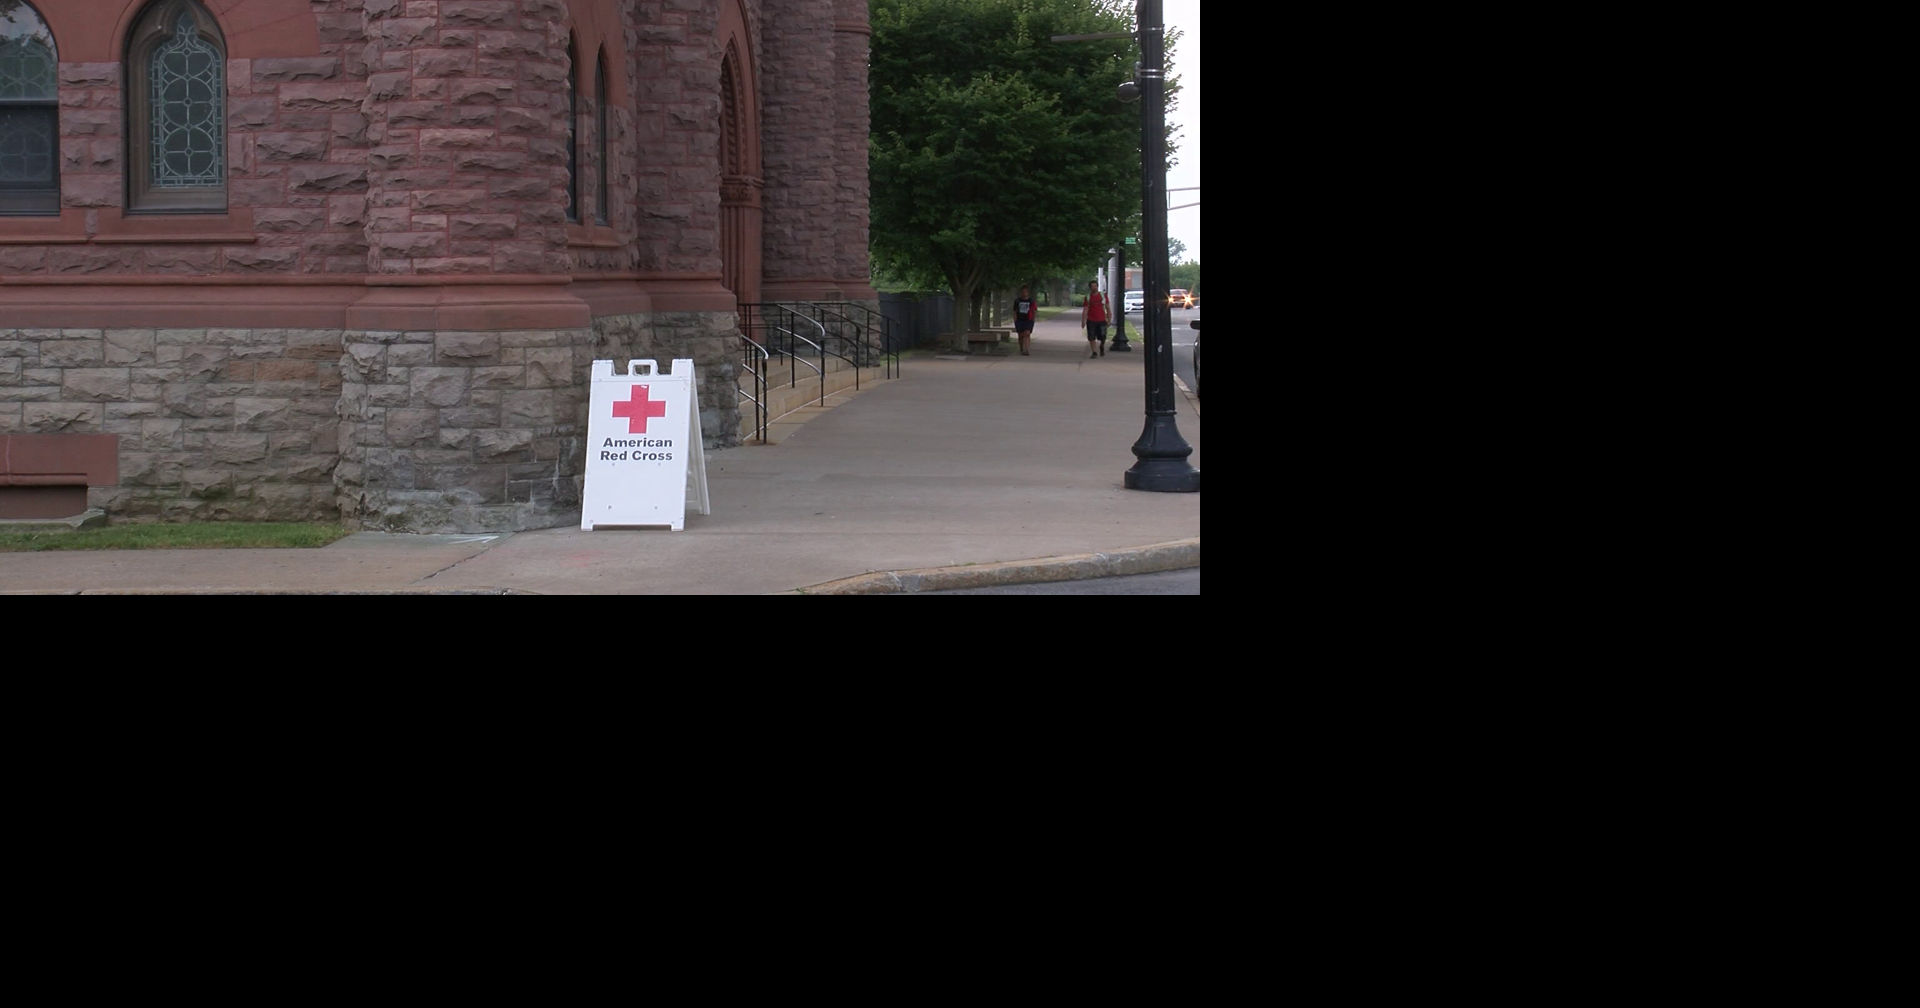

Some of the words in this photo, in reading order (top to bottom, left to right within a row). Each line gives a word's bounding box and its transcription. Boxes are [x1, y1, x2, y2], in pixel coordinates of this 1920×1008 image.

[602, 437, 673, 448] American
[600, 450, 628, 461] Red
[631, 450, 673, 461] Cross
